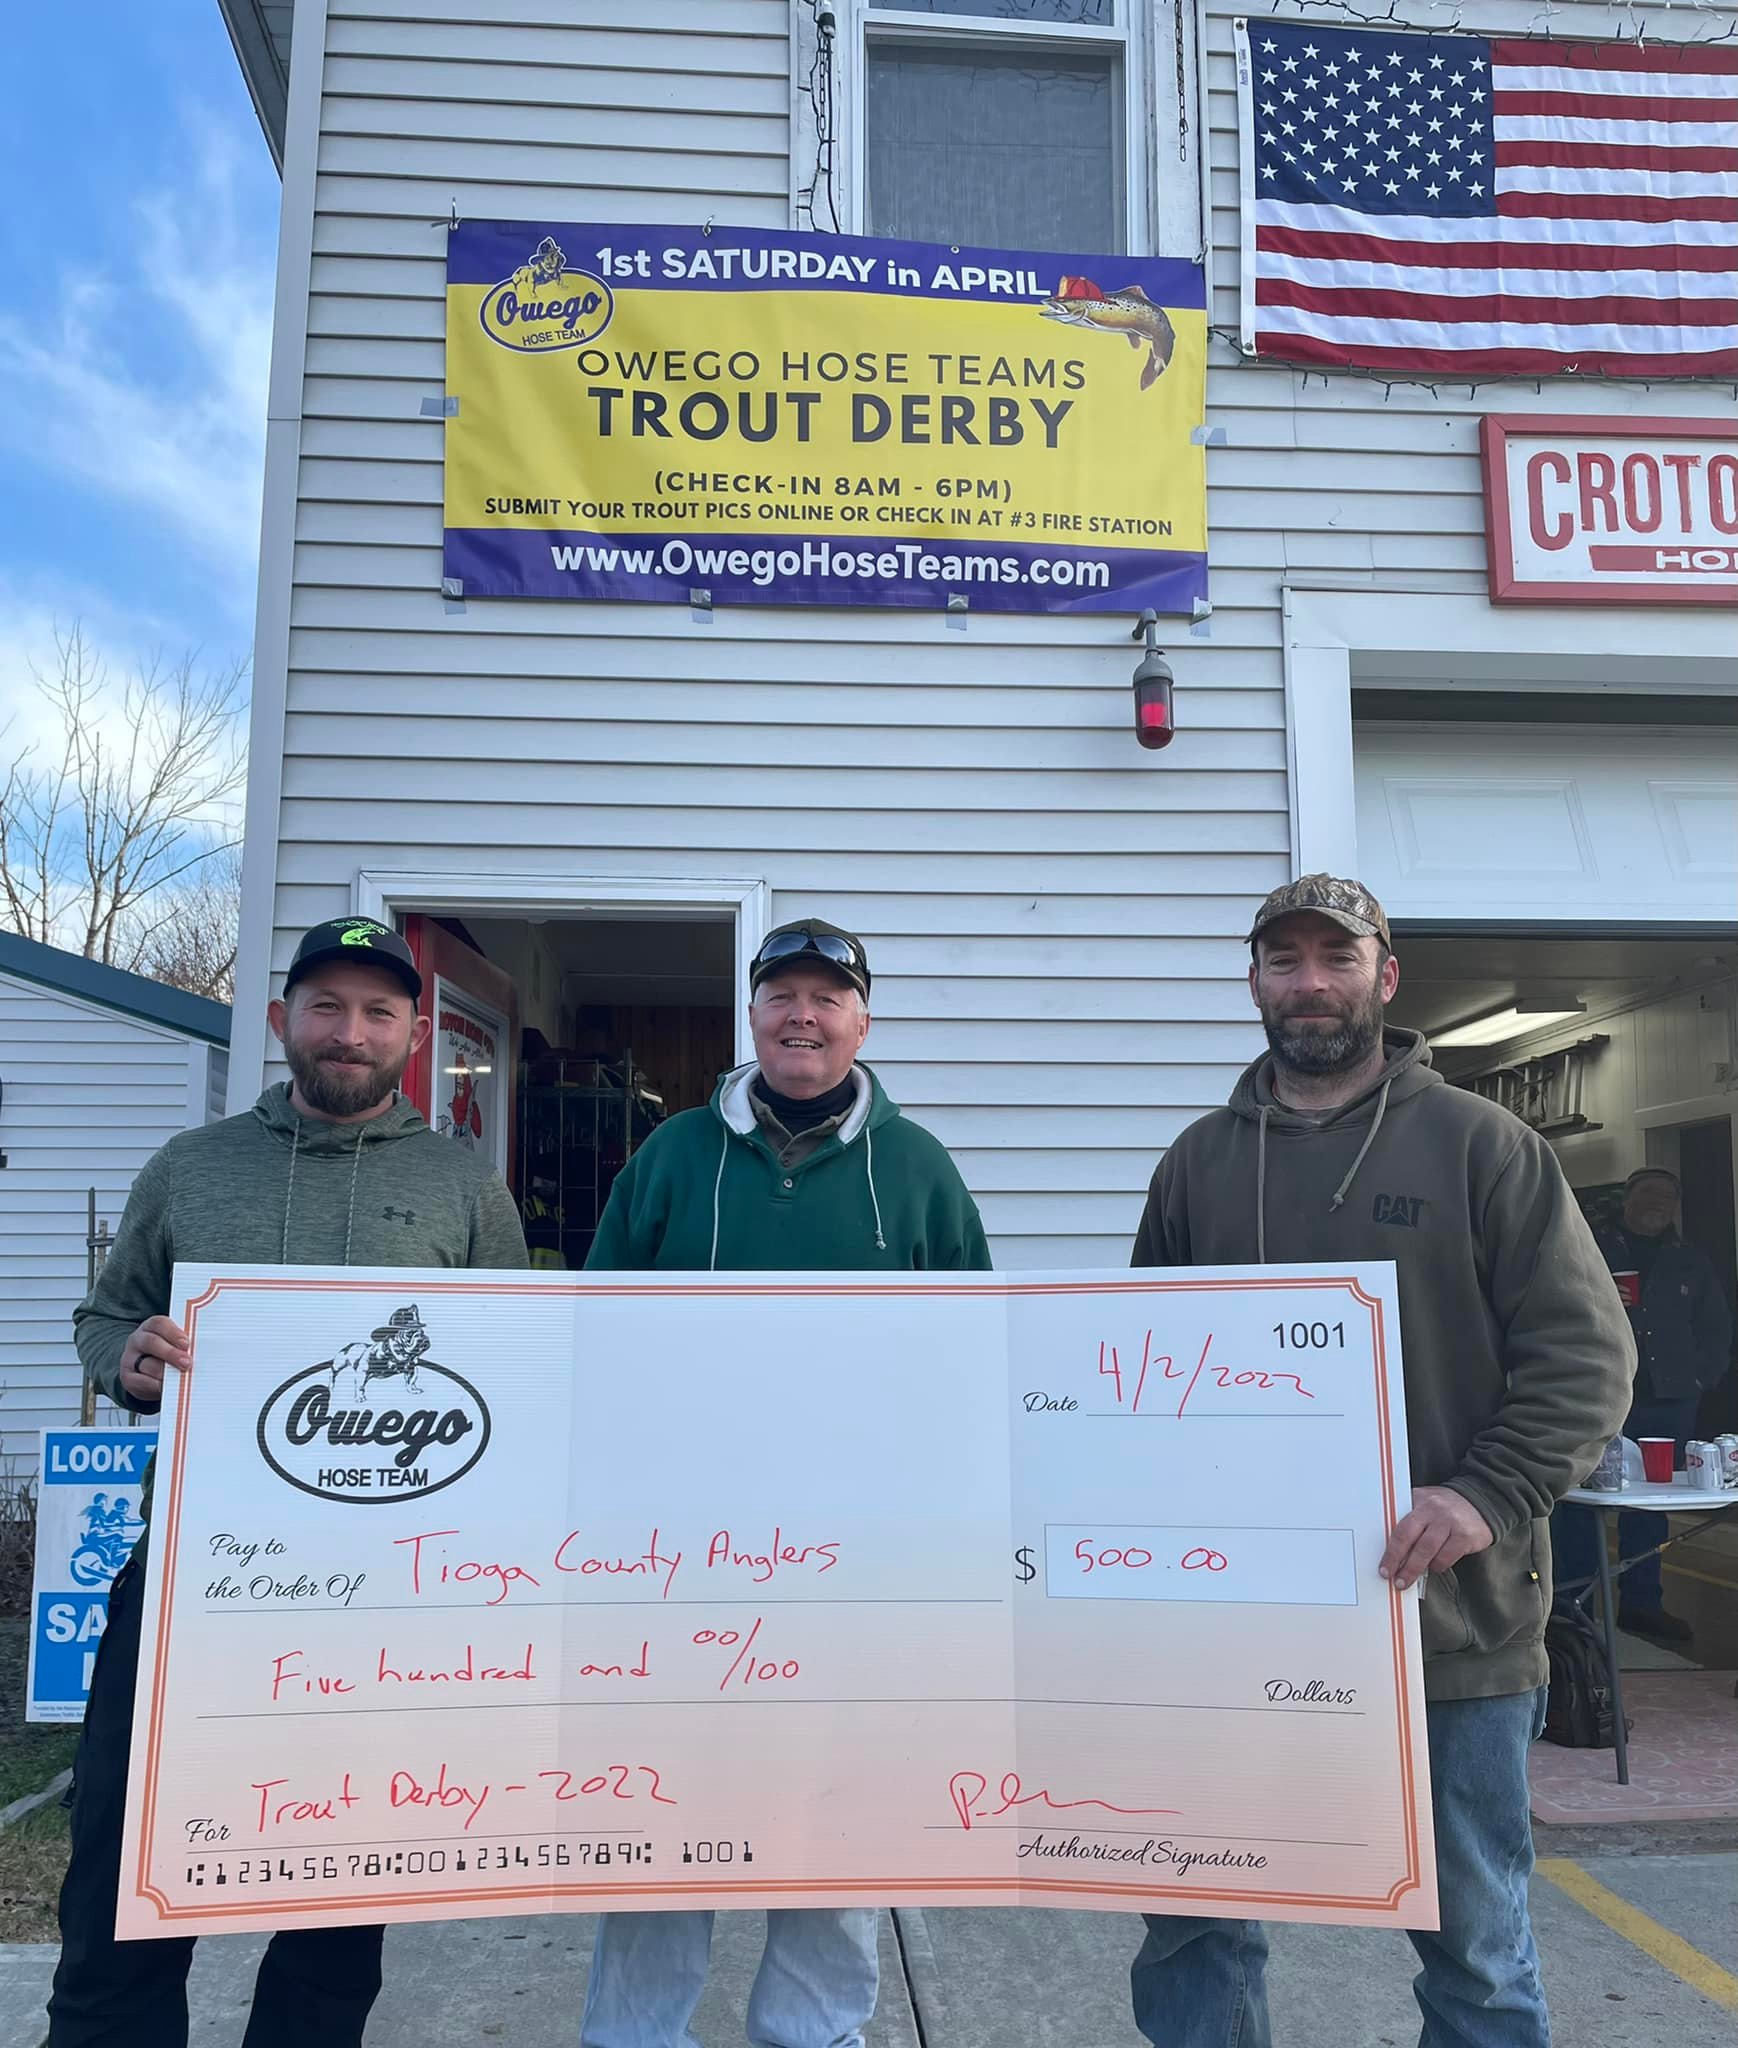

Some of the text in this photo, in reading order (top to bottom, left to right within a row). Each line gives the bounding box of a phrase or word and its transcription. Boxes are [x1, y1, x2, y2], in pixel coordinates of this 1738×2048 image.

[596, 247, 1051, 296] 1st SATURDAY in APRIL
[496, 290, 602, 329] Owego
[522, 329, 586, 346] HOSE TEAM
[577, 349, 1086, 390] OWEGO HOSE TEAMS
[587, 387, 1074, 449] TROUT DERBY
[655, 470, 821, 495] (CHECK-IN
[834, 477, 900, 496] 8AM
[935, 478, 1012, 503] 6PM)
[485, 497, 1172, 535] SUBMIT YOUR TROUT PICS ONLINE OR CHECK IN AT #3 FIRE STATION
[551, 539, 1110, 586] www.OwegoHoseTeams.com
[1655, 550, 1738, 570] HO
[1373, 1194, 1424, 1228] CAT
[1272, 1321, 1345, 1348] 1001
[1023, 1391, 1078, 1413] Date
[285, 1385, 473, 1468] Owego
[51, 1445, 135, 1472] LOOK
[318, 1468, 428, 1487] HOSE TEAM
[209, 1533, 286, 1567] Pay to
[394, 1527, 840, 1605] Tioga County Anglers
[1015, 1545, 1036, 1584] $
[205, 1573, 366, 1606] the Order Of
[46, 1603, 108, 1643] SA
[272, 1650, 355, 1701] Five
[378, 1643, 536, 1683] hundred
[580, 1641, 651, 1677] and
[1264, 1679, 1357, 1705] Dollars
[251, 1773, 360, 1833] Trout
[185, 1818, 231, 1843] For
[682, 1841, 753, 1863] 1001
[1016, 1834, 1268, 1877] Authorized Signature
